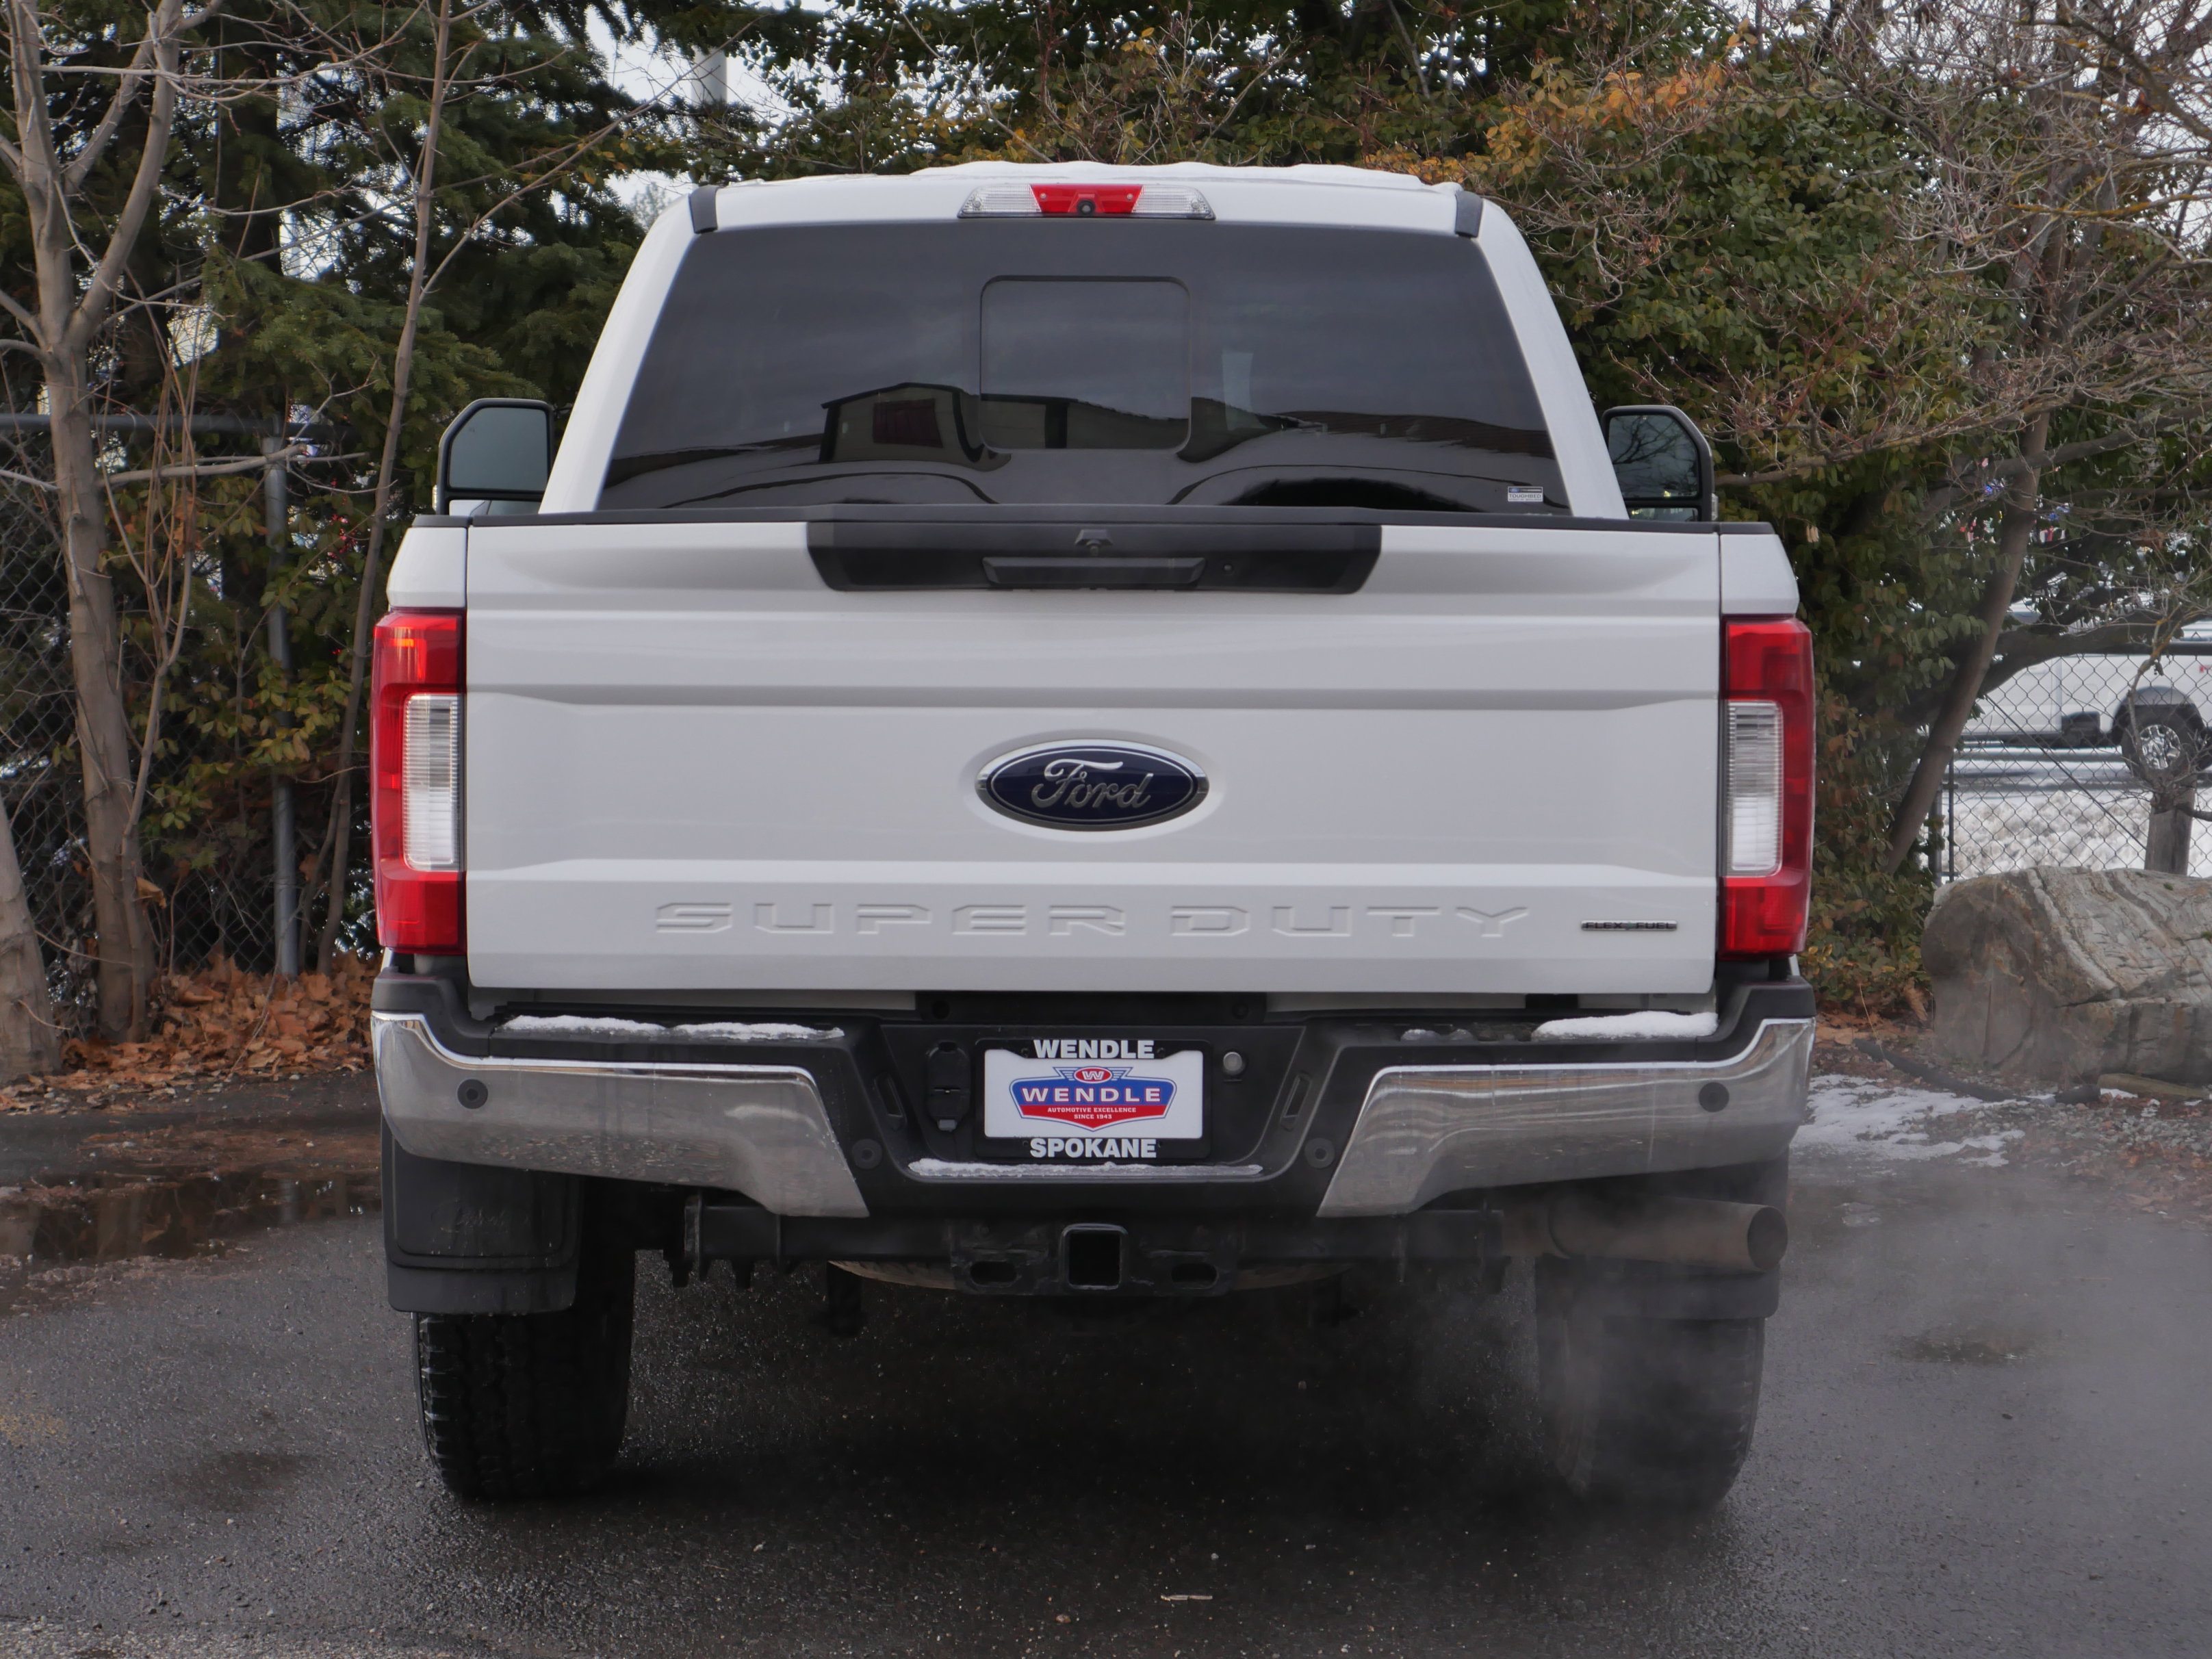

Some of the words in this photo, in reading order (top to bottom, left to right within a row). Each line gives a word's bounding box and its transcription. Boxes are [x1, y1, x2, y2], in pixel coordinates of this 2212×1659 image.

[1031, 758, 1154, 808] Ford
[656, 903, 1126, 935] SUPER
[1170, 905, 1529, 936] DUTY
[1033, 1040, 1155, 1059] WENDLE
[1022, 1088, 1161, 1102] WENDLE
[1030, 1138, 1157, 1158] SPOKANE
